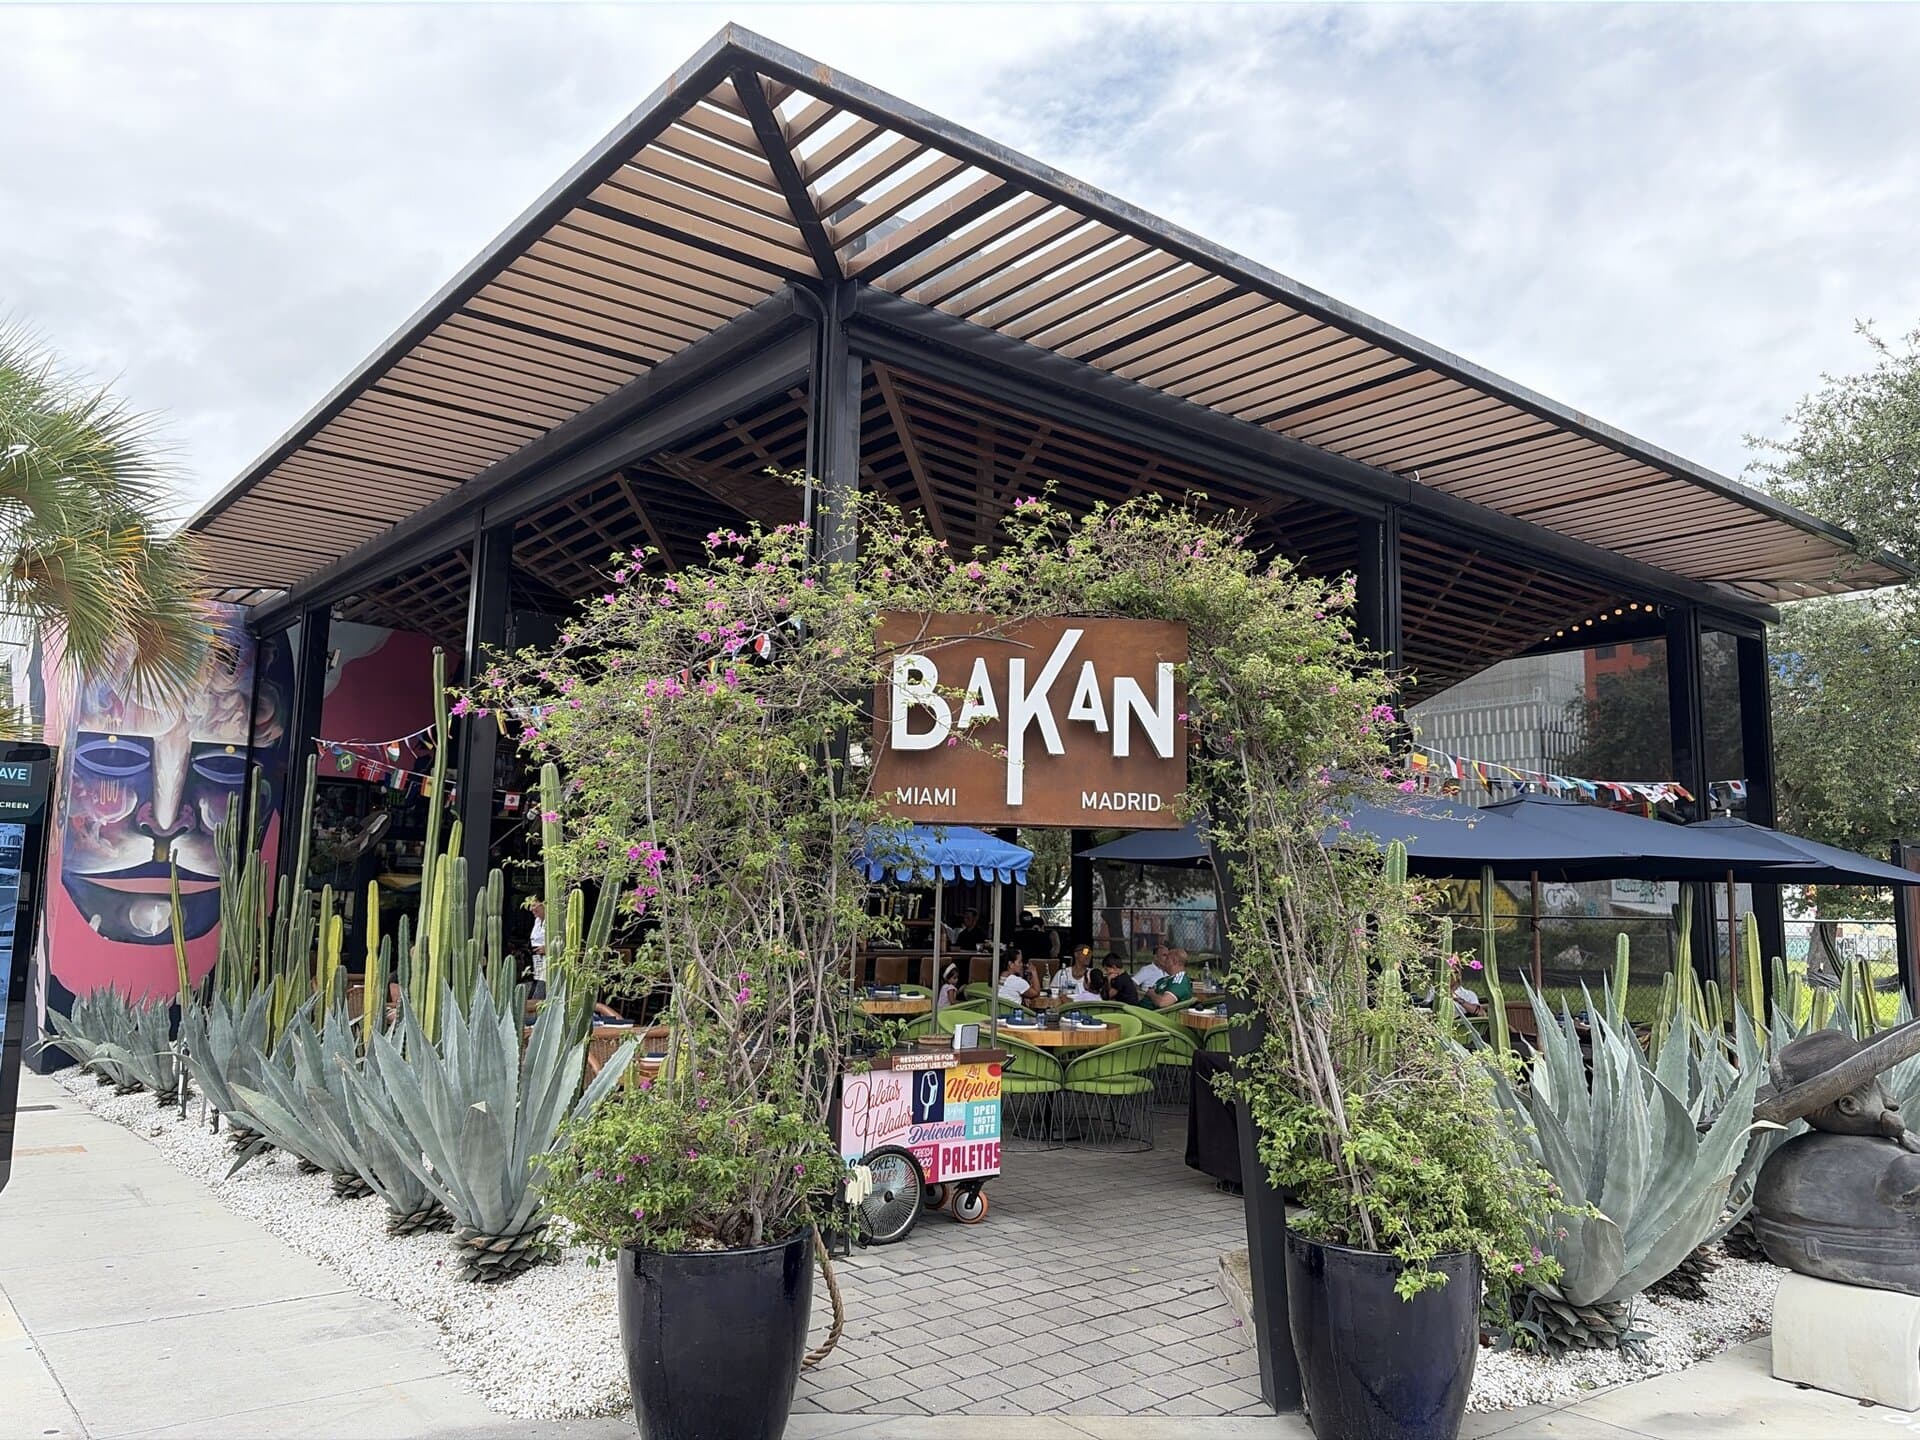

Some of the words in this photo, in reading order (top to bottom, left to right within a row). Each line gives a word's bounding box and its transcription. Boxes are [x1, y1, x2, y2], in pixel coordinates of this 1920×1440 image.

[891, 629, 1174, 805] BAKAN
[896, 787, 956, 806] MIAMI
[1081, 791, 1160, 812] MADRID
[895, 1062, 928, 1071] CUSTOMER
[930, 1061, 941, 1069] USE
[942, 1060, 958, 1068] ONLY
[900, 1055, 933, 1063] RESTROOM
[946, 1077, 1000, 1102] Mejores
[844, 1079, 902, 1127] Paletas
[973, 1104, 996, 1116] OPEN
[908, 1122, 967, 1145] Deliciosas
[973, 1124, 995, 1136] LATE
[942, 1142, 1000, 1175] PALETAS
